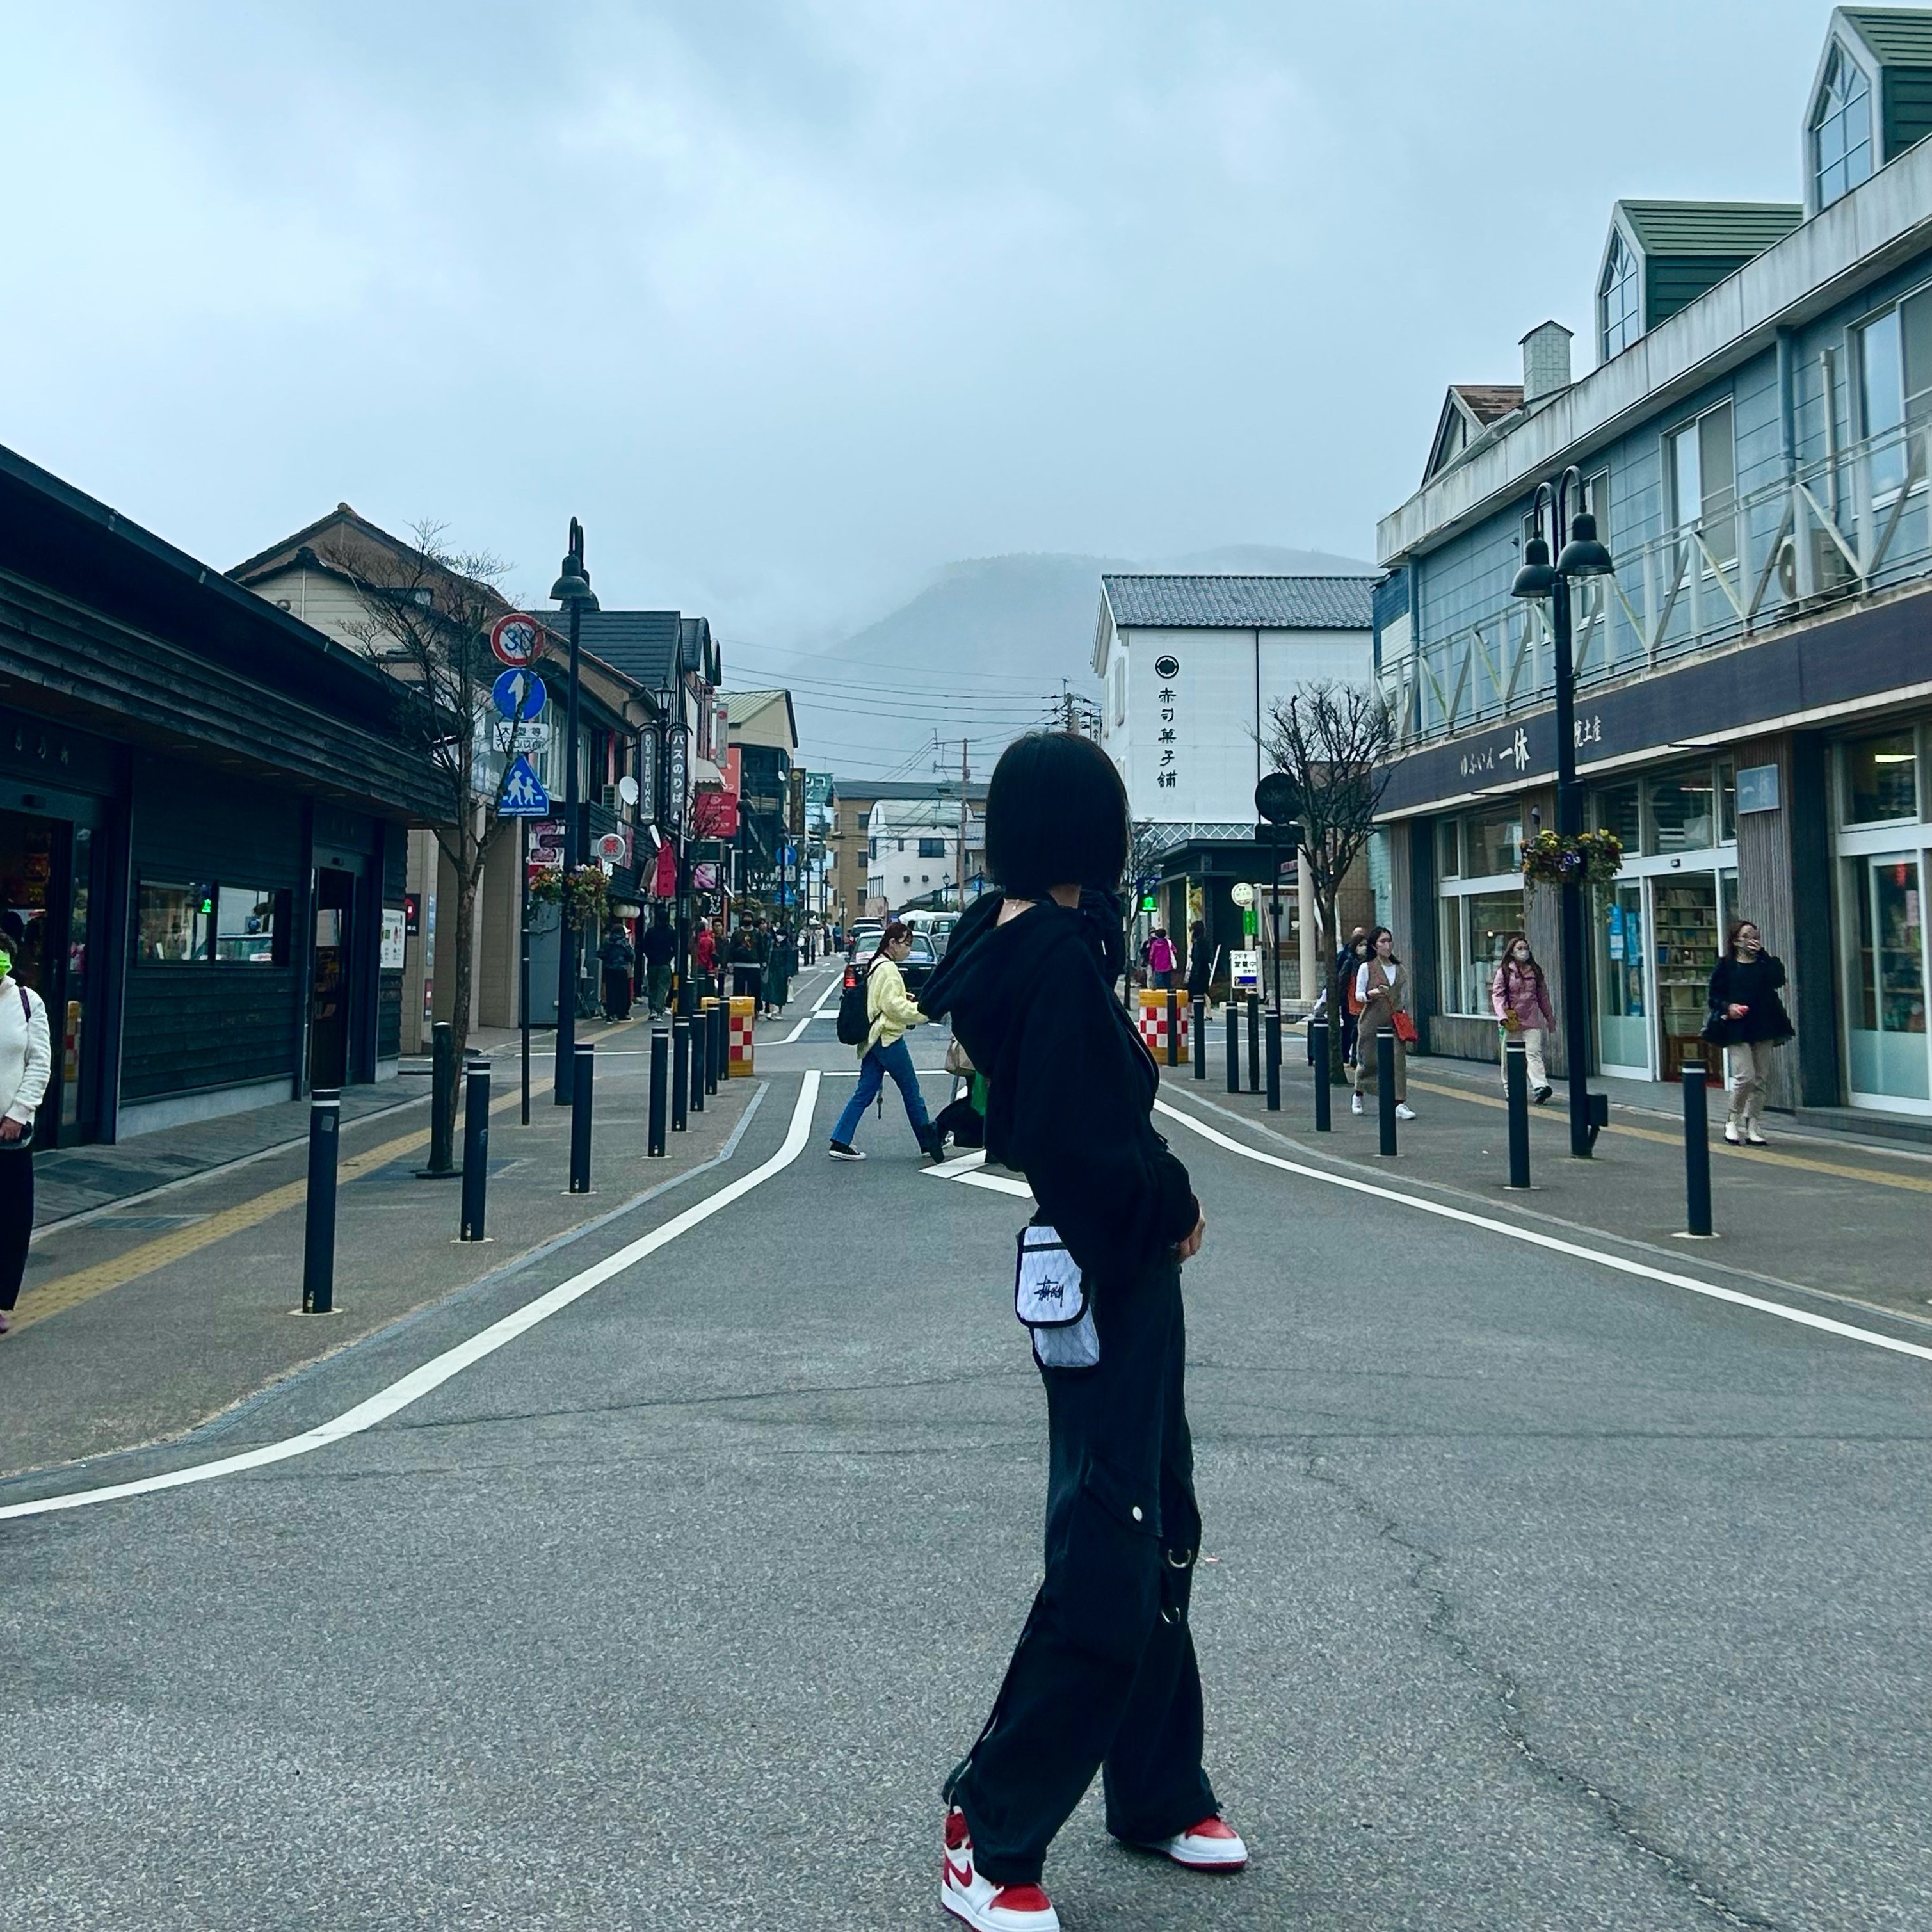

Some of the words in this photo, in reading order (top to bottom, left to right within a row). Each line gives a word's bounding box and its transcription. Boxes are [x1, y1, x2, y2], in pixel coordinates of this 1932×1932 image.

[1157, 687, 1178, 788] 赤司菓子舗
[1498, 727, 1531, 771] 一休
